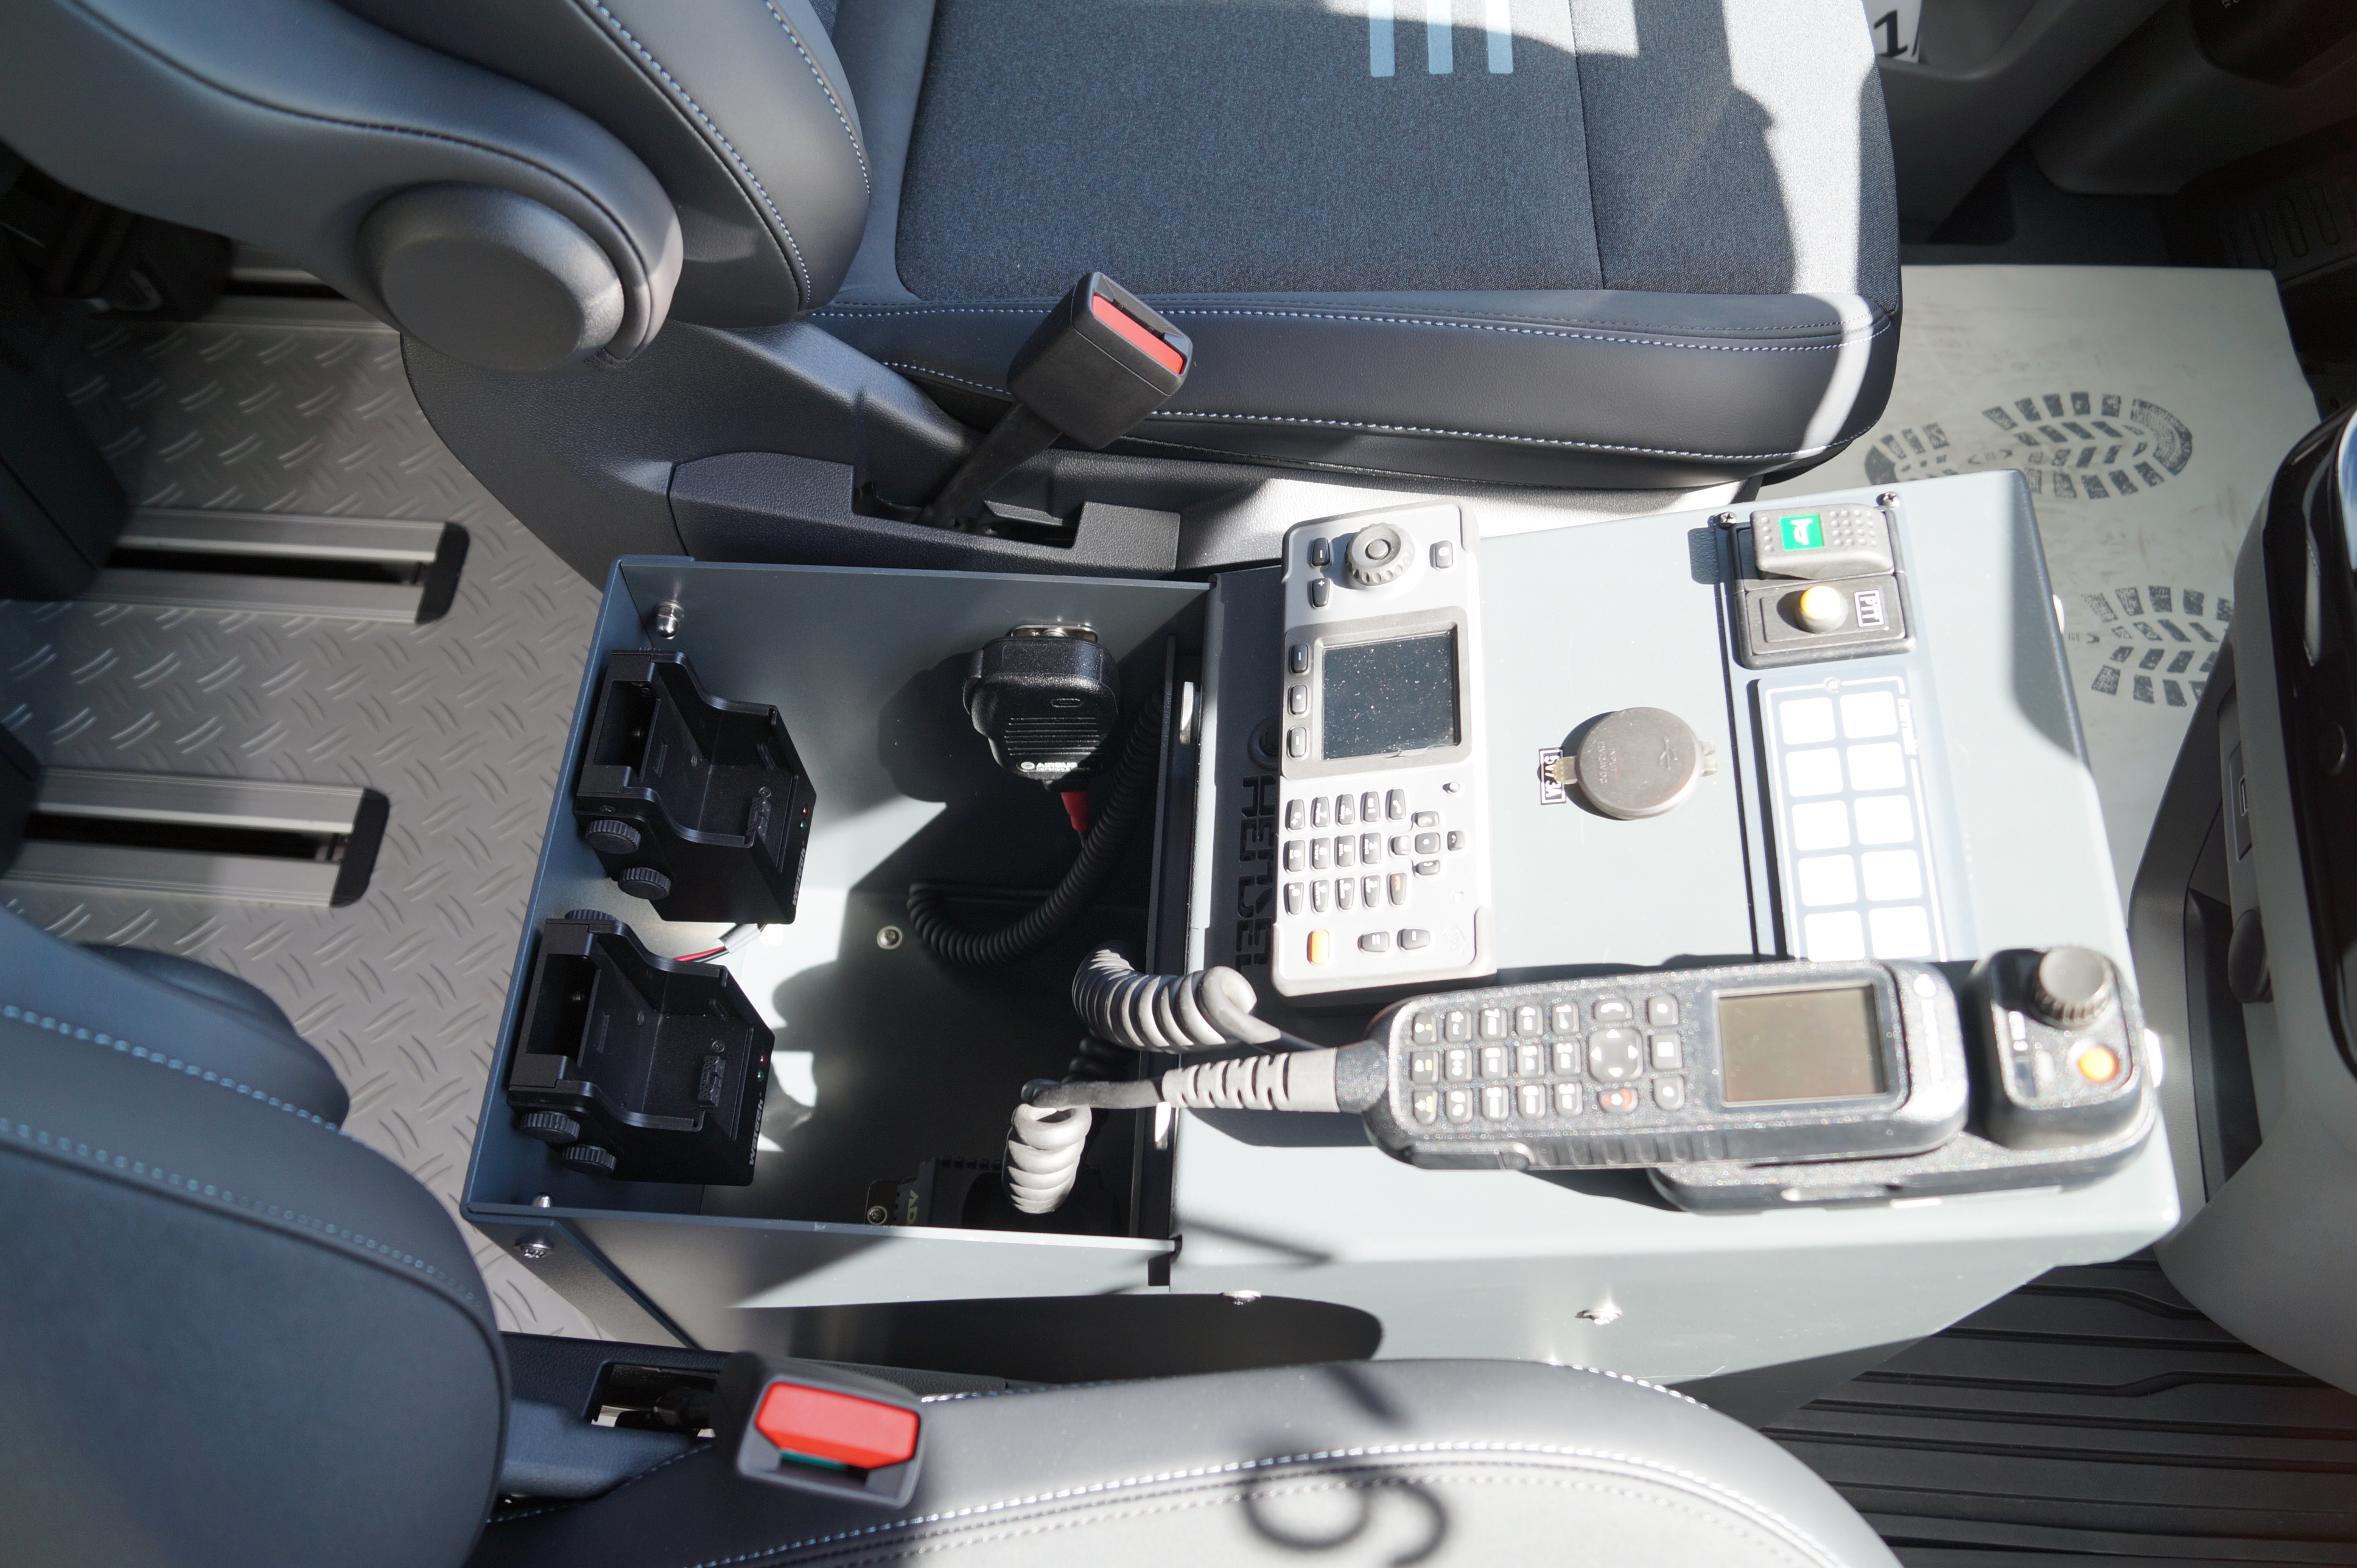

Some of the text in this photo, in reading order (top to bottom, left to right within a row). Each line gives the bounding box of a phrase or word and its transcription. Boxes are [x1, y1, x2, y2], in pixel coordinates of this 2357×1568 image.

[1859, 596, 1879, 620] PTT
[1609, 748, 1617, 773] INPUT
[1369, 841, 1378, 850] 2
[1235, 774, 1278, 974] HENSEL
[1485, 1008, 1500, 1018] 7
[1557, 1043, 1573, 1053] 2
[1558, 1083, 1575, 1094] 3
[906, 1189, 919, 1226] AD
